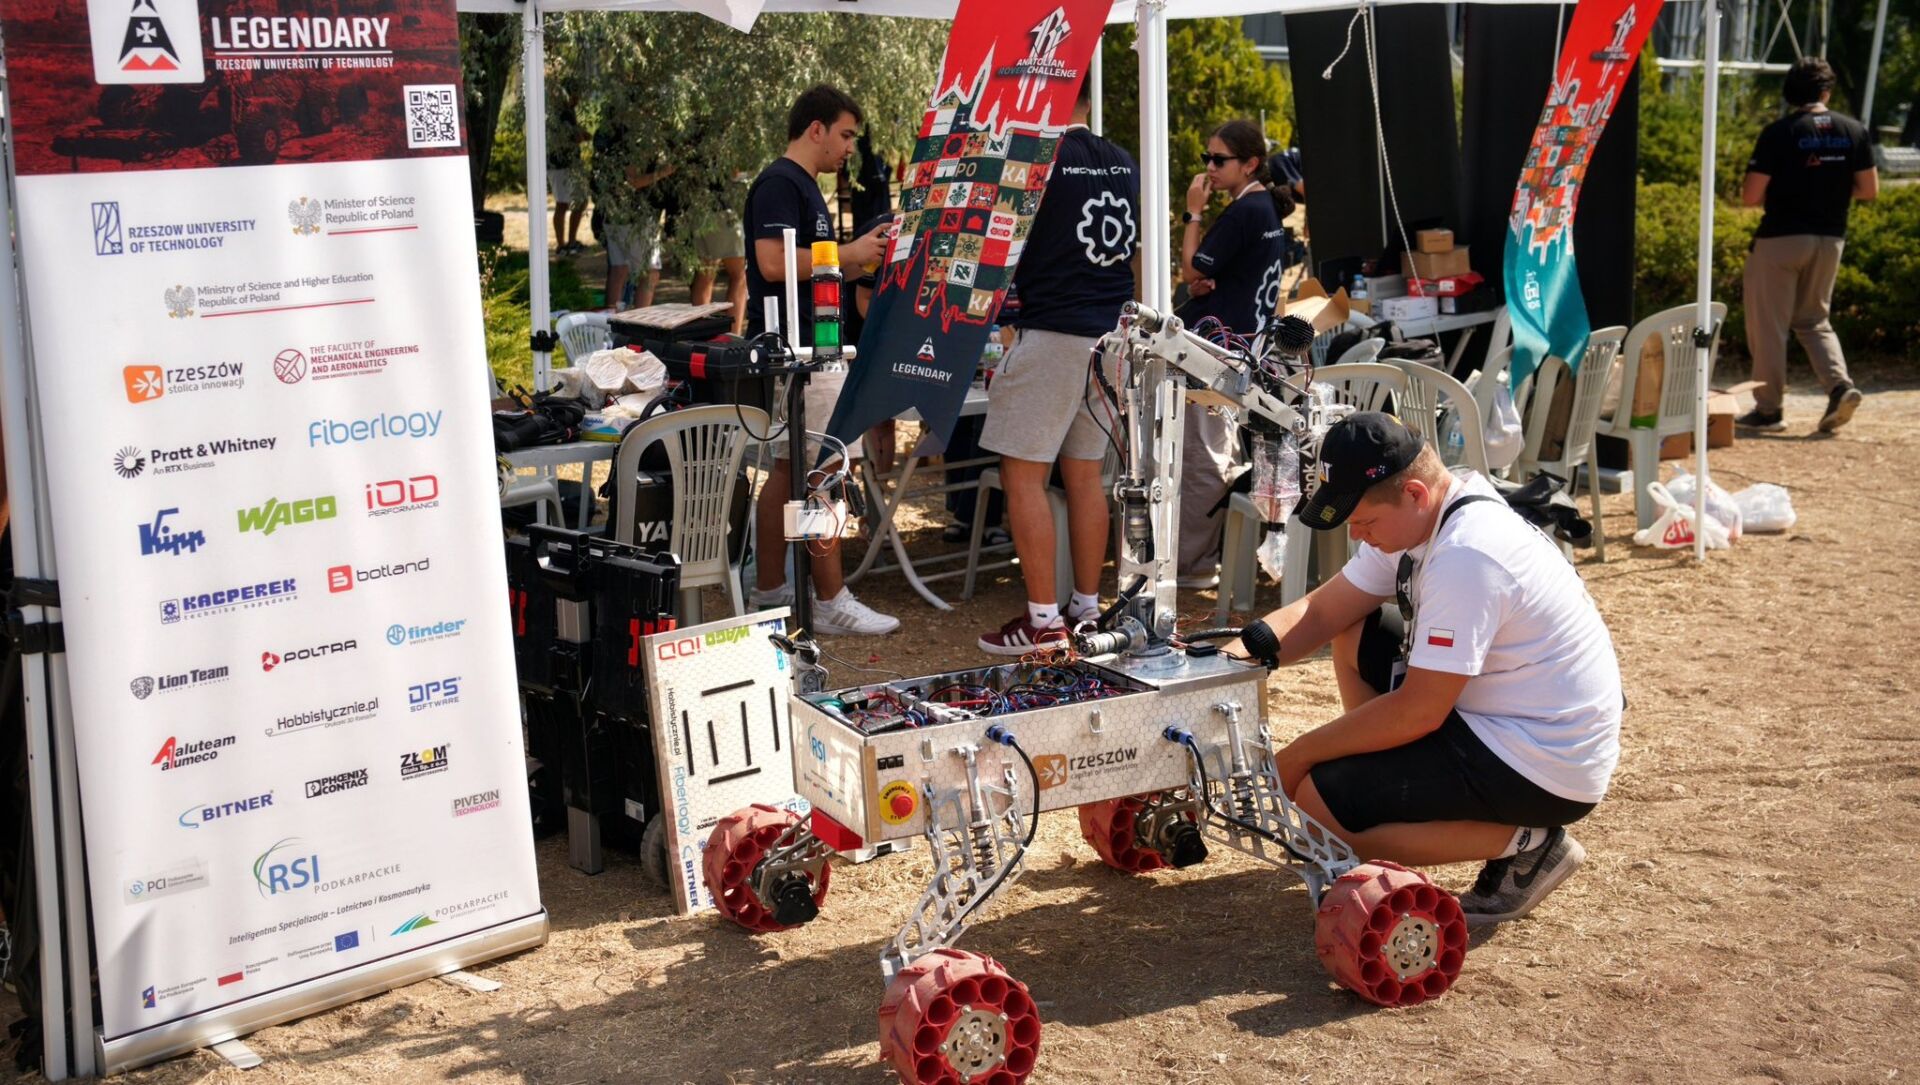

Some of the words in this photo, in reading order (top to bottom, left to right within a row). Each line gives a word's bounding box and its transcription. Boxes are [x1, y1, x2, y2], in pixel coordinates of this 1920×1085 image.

[211, 16, 390, 49] LEGENDARY
[215, 58, 261, 71] RZESZOW
[263, 58, 319, 70] UNIVERSITY
[322, 58, 333, 69] OF
[336, 57, 394, 69] TECHNOLOGY
[1016, 57, 1065, 68] ANATOLIAN
[1026, 65, 1078, 78] CHALLENGE
[324, 198, 365, 210] Minister
[368, 197, 377, 207] of
[379, 195, 415, 206] Science
[326, 211, 368, 225] Republic
[370, 210, 379, 220] of
[381, 208, 414, 220] Poland
[128, 224, 184, 239] RZESZOW
[186, 219, 256, 236] UNIVERSITY
[129, 241, 145, 253] OF
[149, 236, 224, 252] TECHNOLOGY
[197, 283, 235, 297] Ministry
[236, 283, 246, 293] of
[249, 280, 282, 292] Science
[284, 278, 299, 289] and
[301, 275, 329, 288] Higher
[331, 272, 374, 284] Education
[198, 295, 238, 309] Republic
[239, 294, 248, 304] of
[249, 291, 280, 303] Poland
[309, 346, 325, 354] THE
[328, 342, 362, 353] FACULTY
[364, 340, 375, 349] OF
[310, 352, 362, 364] MECHANICAL
[365, 345, 419, 358] ENGINEERING
[166, 361, 243, 384] rzeszów
[311, 365, 329, 374] AND
[330, 358, 388, 372] AERONAUTICS
[892, 362, 953, 382] LEGENDARY
[168, 382, 199, 394] stolica
[201, 377, 245, 390] innowacji
[151, 447, 193, 463] Pratt
[196, 443, 208, 457] &
[209, 437, 277, 456] Whitney
[153, 466, 164, 475] An
[165, 464, 183, 473] RTX
[183, 460, 215, 471] Business
[237, 496, 337, 536] WAGO
[368, 500, 439, 517] PERFORMANCE
[138, 507, 206, 556] Kipp
[356, 557, 430, 582] botland
[183, 578, 296, 611] KACPEREK
[408, 619, 465, 639] finder
[284, 639, 358, 663] POLTRA
[158, 674, 188, 690] Lion
[189, 665, 229, 683] Team
[408, 676, 459, 704] DPS
[277, 697, 379, 731] Hobbistycznie.pl
[410, 696, 459, 713] SOFTWARE
[1070, 747, 1137, 771] rzeszów
[322, 777, 368, 794] CONTACT
[202, 793, 273, 821] BITNER
[454, 790, 499, 809] PIVEXIN
[455, 800, 499, 816] TECHNOLOGY
[147, 877, 166, 892] PCI
[268, 854, 320, 895] RSI
[314, 863, 401, 894] PODKARPACKIE
[685, 860, 699, 908] BITNER
[229, 924, 277, 945] Inteligentna
[278, 910, 328, 933] Specjalizacja
[378, 882, 431, 903] Kosmonautyka
[435, 890, 508, 917] PODKARPACKIE
